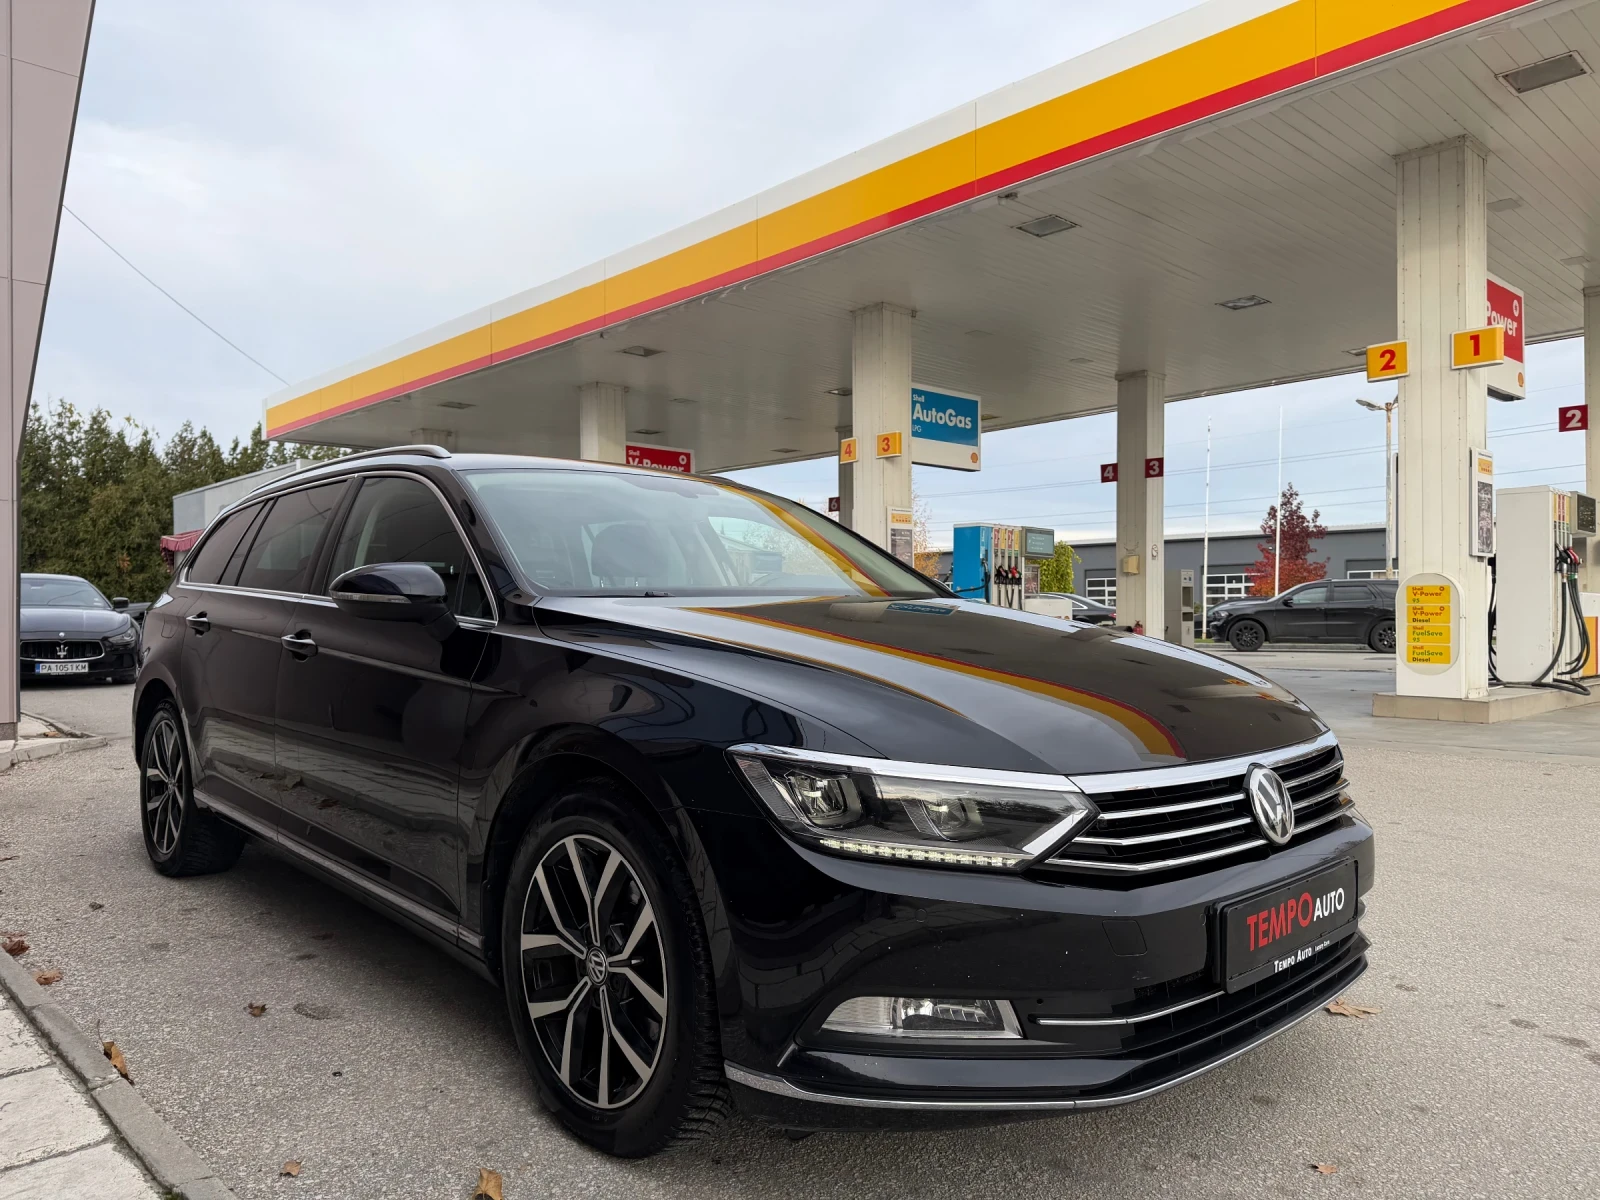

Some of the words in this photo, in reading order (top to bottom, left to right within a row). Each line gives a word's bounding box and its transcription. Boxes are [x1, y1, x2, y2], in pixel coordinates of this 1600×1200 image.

[1469, 334, 1480, 356] 1
[1379, 349, 1396, 371] 2
[912, 394, 925, 402] Shell
[912, 403, 972, 429] AutoGas
[1565, 409, 1582, 428] 2
[844, 443, 852, 457] 4
[881, 436, 891, 452] 3
[1103, 465, 1114, 480] 4
[1148, 460, 1160, 475] 3
[830, 499, 838, 510] 6
[54, 664, 74, 672] 1051
[75, 663, 87, 671] KM
[1247, 892, 1313, 951] TEMPO
[1313, 887, 1345, 922] AUTO
[1296, 947, 1312, 963] AUTO
